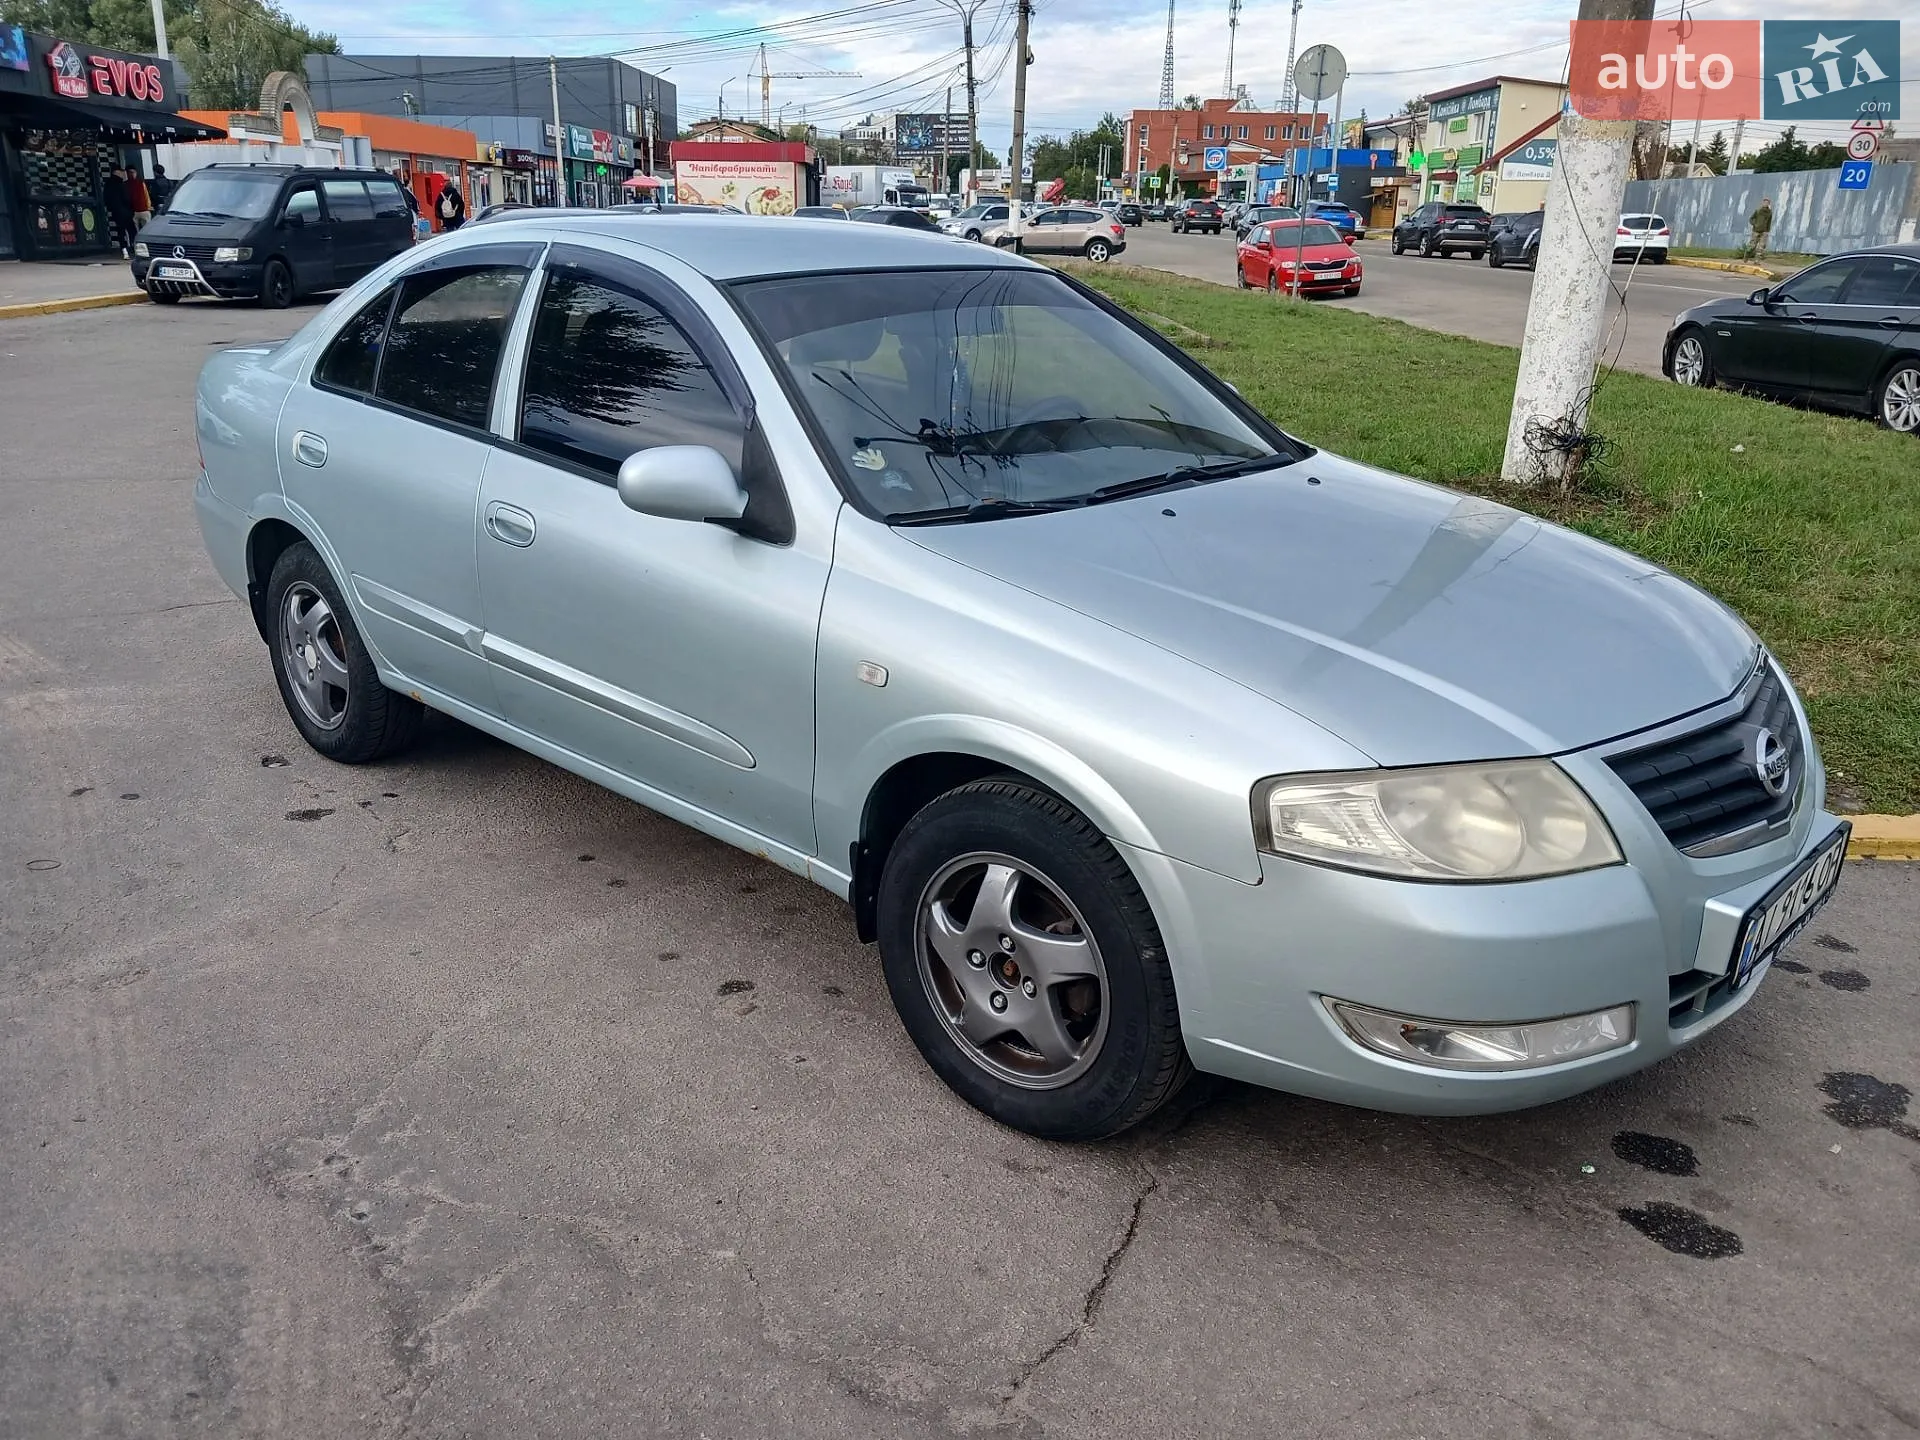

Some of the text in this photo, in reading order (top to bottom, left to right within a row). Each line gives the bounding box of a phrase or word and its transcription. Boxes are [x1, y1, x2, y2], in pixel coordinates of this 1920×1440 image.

[89, 55, 163, 102] EVOS
[1854, 139, 1871, 153] 30
[689, 163, 777, 174] Напівфабрикати
[1844, 168, 1866, 183] 20
